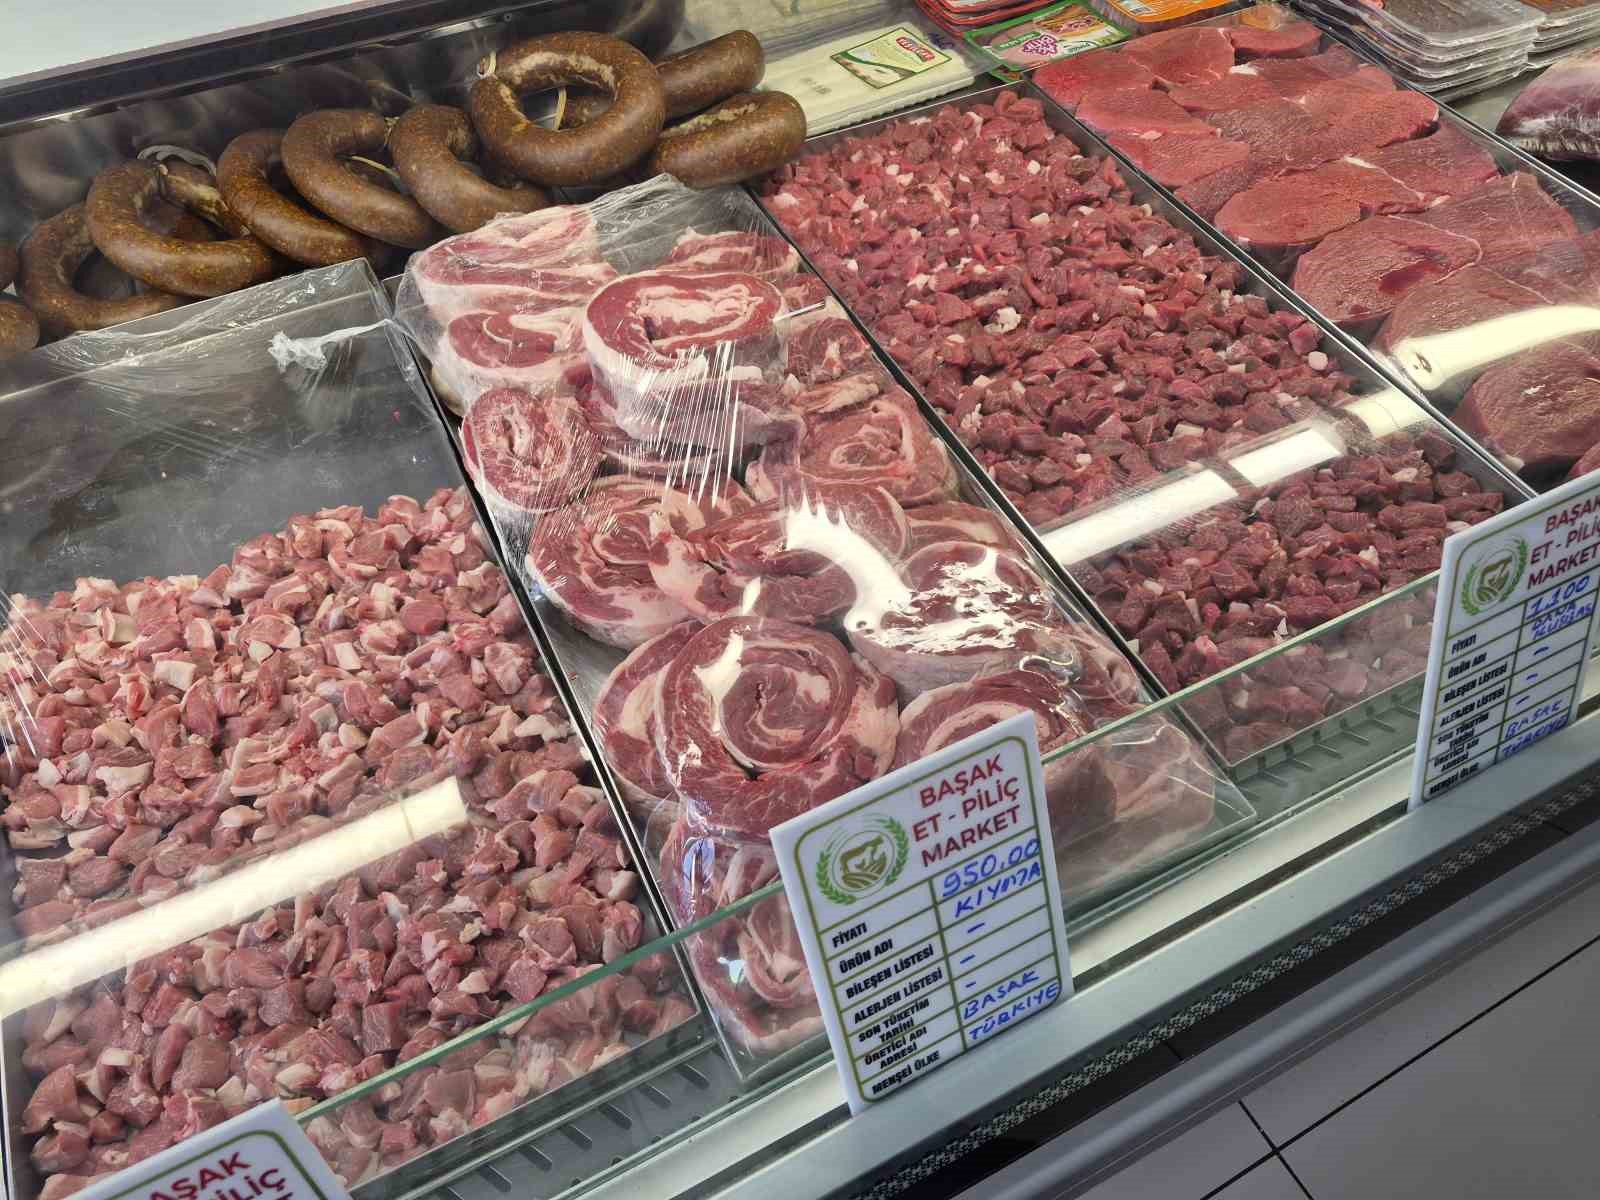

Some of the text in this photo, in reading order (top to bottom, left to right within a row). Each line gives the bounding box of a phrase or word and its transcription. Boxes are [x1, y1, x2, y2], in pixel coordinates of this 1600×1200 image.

[1527, 541, 1600, 590] MARKET
[1530, 540, 1553, 565] ET
[1451, 633, 1477, 655] FİYATI
[1444, 661, 1508, 703] BİLEŞEN LİSTESİ
[1448, 652, 1487, 679] ÜRÜN ADI
[1440, 702, 1475, 728] ALERJEN
[919, 753, 1004, 809] BAŞAK
[912, 812, 942, 842] ET
[961, 777, 1020, 819] PİLİÇ
[921, 804, 1020, 868] MARKET
[832, 921, 868, 949] FİYATI
[840, 939, 893, 974] ÜRÜN ADI
[845, 943, 934, 1000] BİLEŞEN LİSTESİ
[854, 966, 943, 1025] ALERJEN LİSTESİ
[859, 998, 930, 1043] SON TÜKETİM
[909, 1026, 928, 1042] ADI
[914, 1050, 940, 1071] ÜLKE
